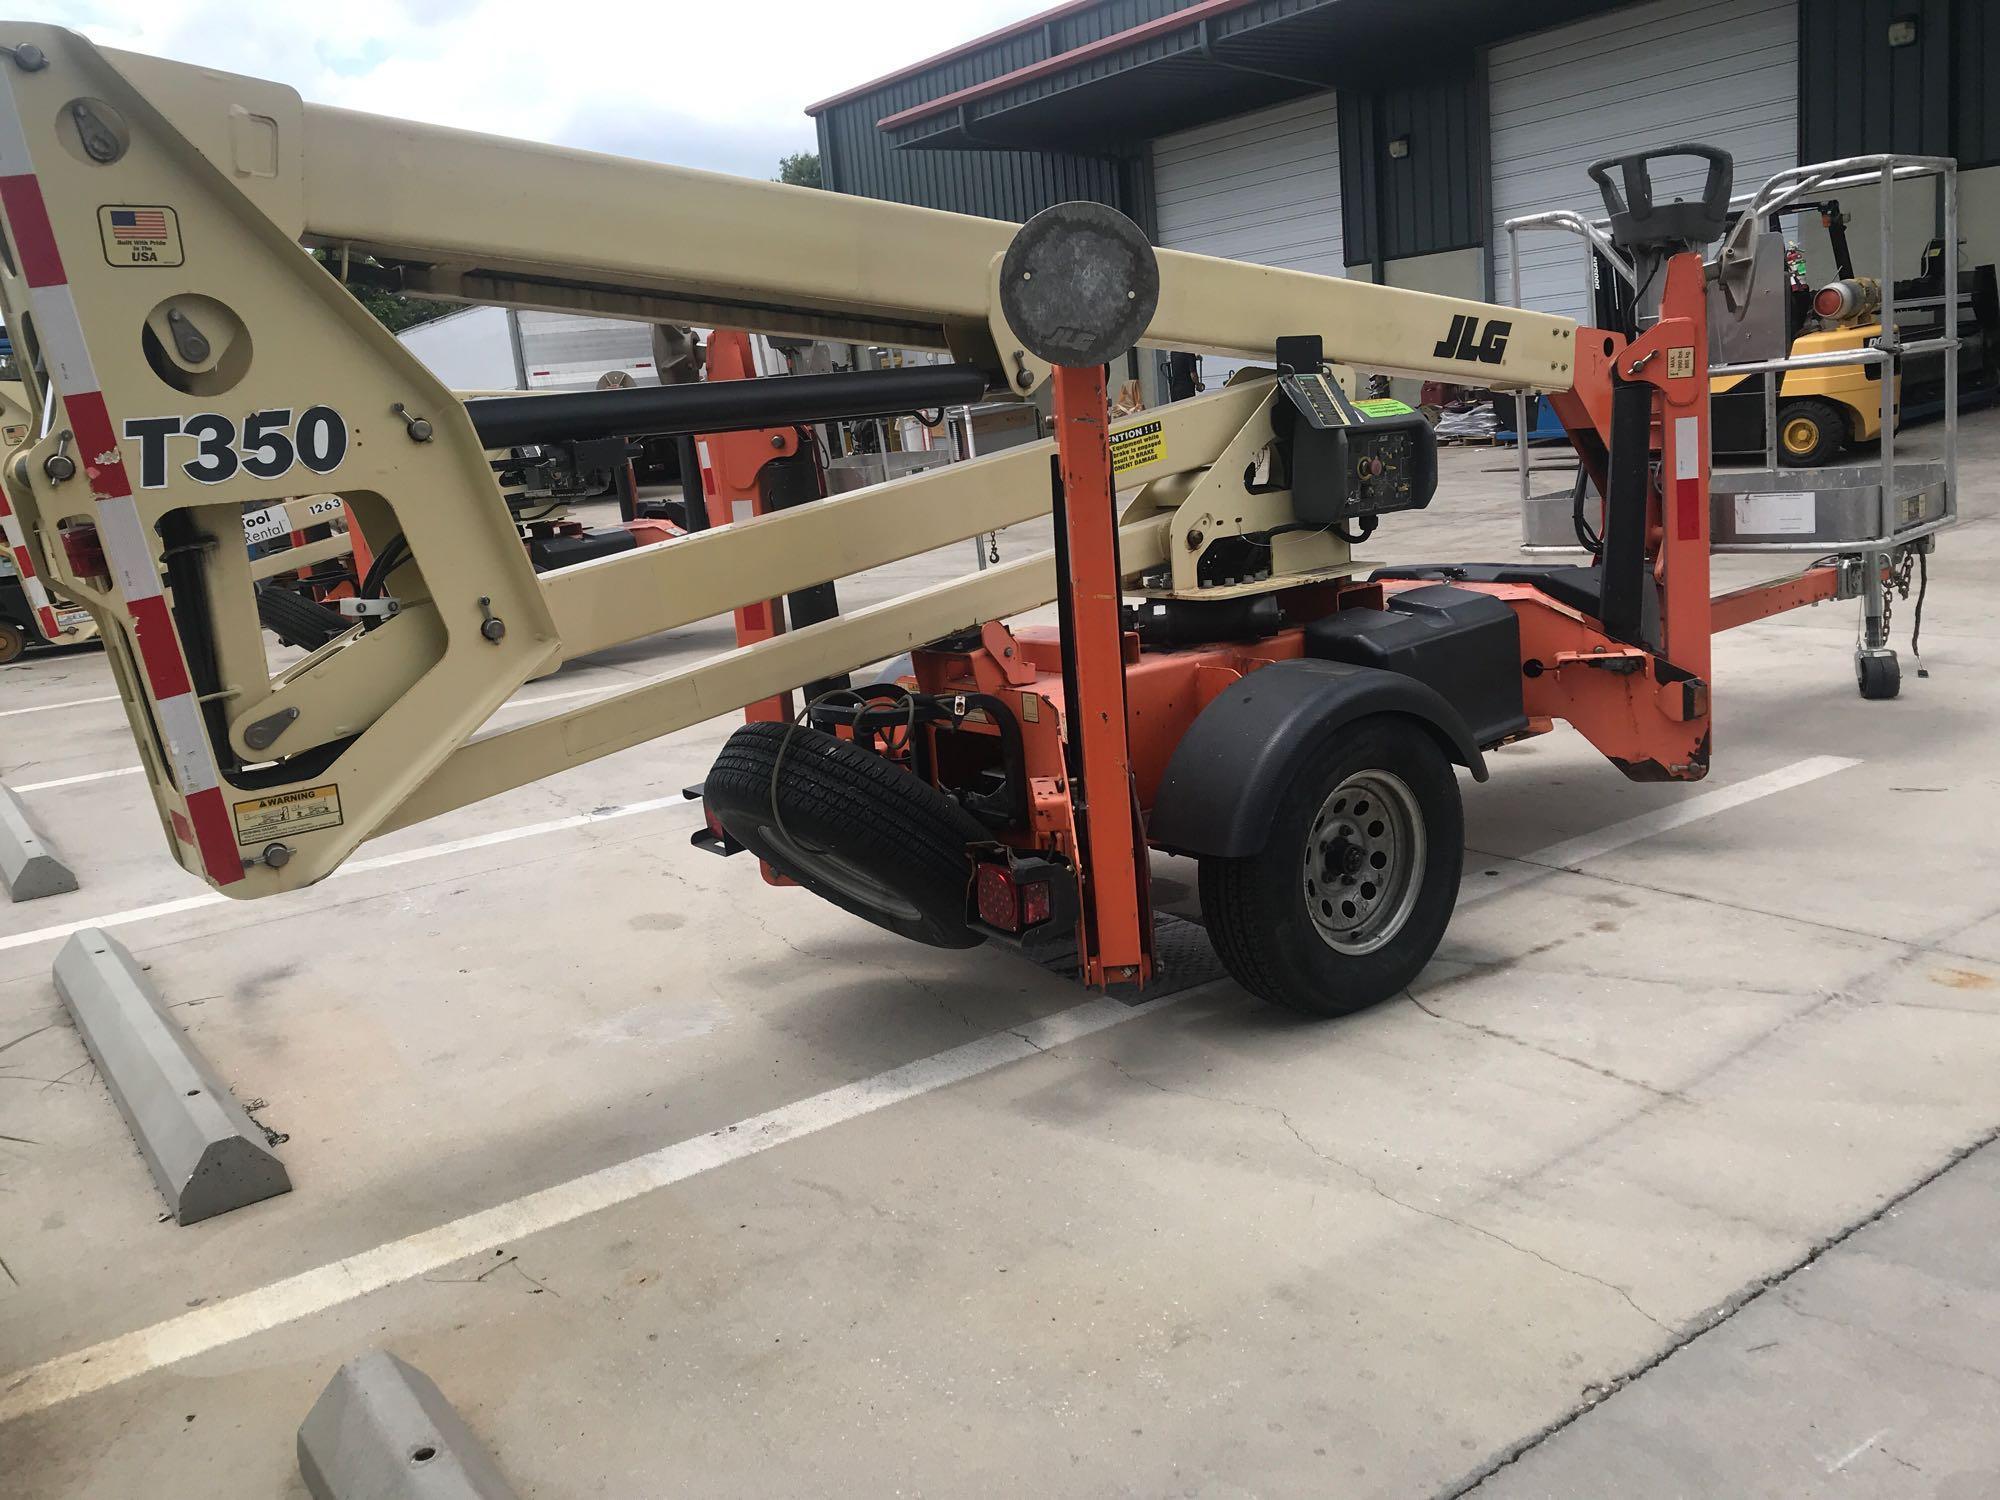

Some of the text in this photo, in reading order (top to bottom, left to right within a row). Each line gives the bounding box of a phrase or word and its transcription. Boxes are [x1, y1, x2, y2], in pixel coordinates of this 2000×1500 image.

[132, 252, 158, 261] USA
[1433, 314, 1512, 364] JLG
[124, 405, 348, 489] T350
[1113, 457, 1128, 465] esult
[1114, 461, 1134, 472] ONENT
[309, 498, 341, 515] 1263
[242, 510, 271, 529] ool
[245, 520, 285, 544] Rental
[267, 791, 316, 807] WARNING
